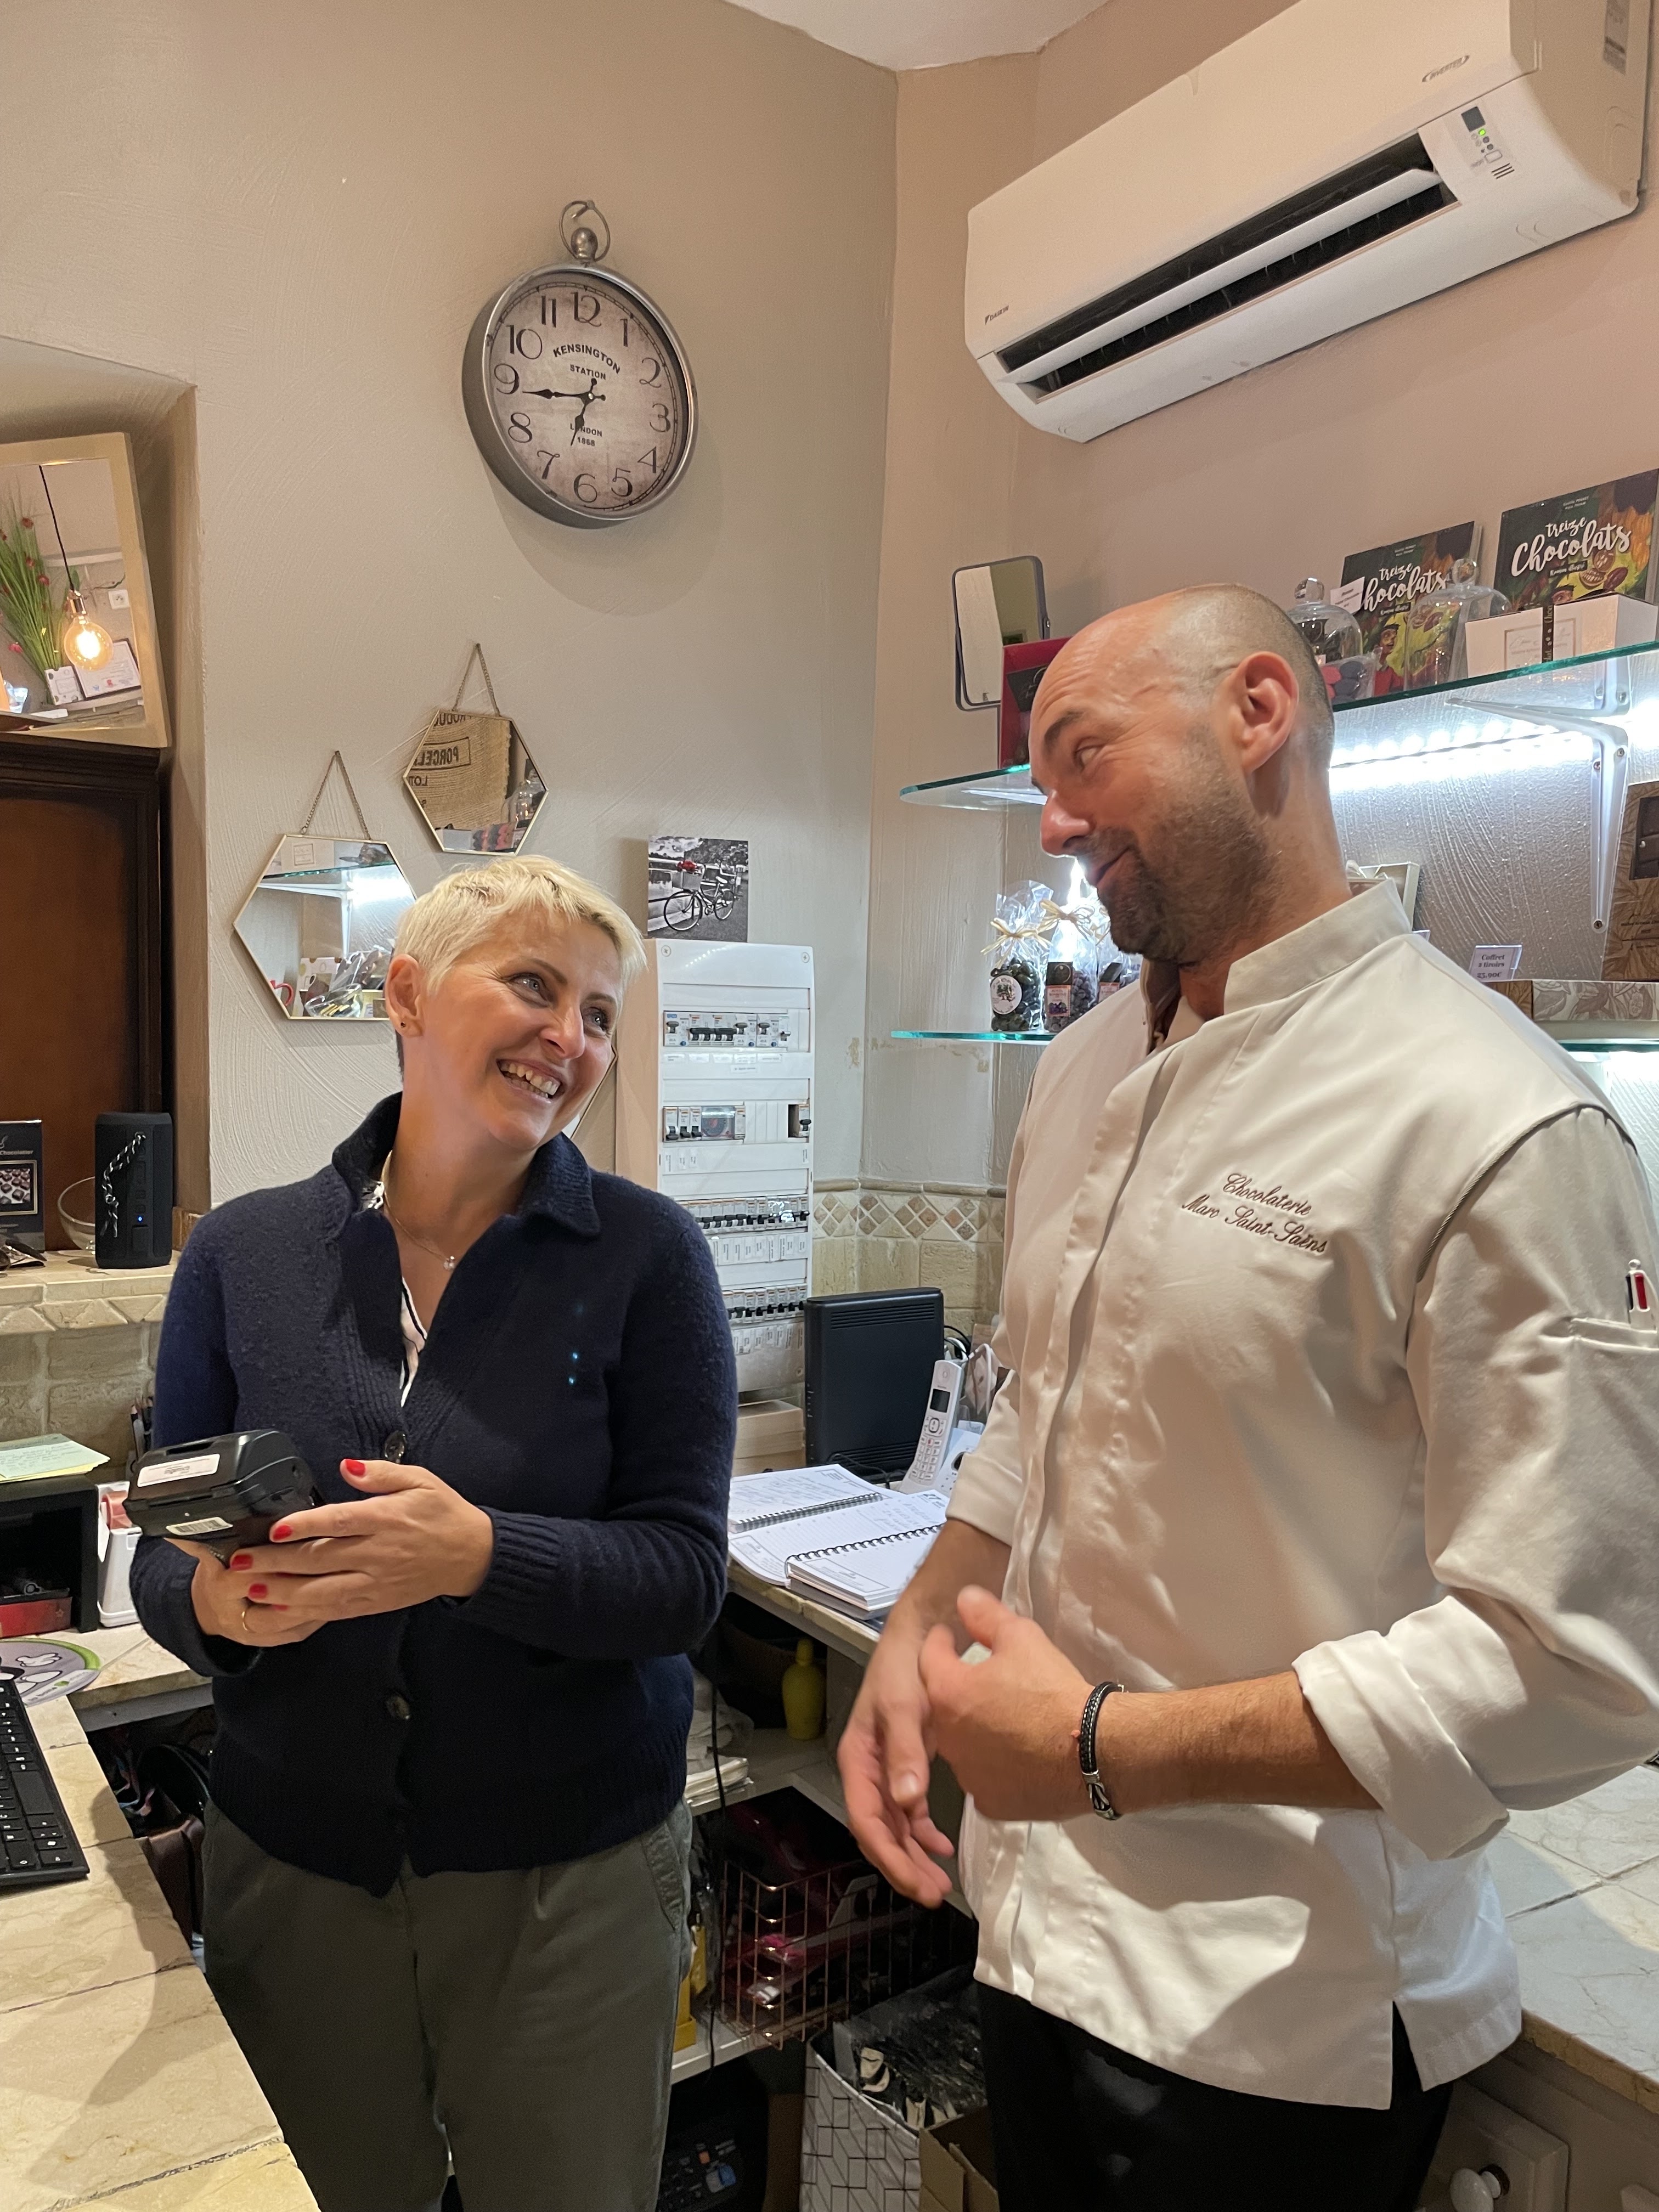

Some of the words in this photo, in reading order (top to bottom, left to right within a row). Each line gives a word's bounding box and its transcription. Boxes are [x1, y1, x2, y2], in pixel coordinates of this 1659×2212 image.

[540, 295, 556, 328] 11
[570, 291, 602, 327] 12
[506, 325, 543, 360] 10
[620, 318, 629, 347] 1
[552, 344, 620, 374] KENSINGTON
[569, 364, 606, 380] STATION
[639, 357, 662, 388] 2
[494, 363, 520, 394] 9
[507, 412, 533, 443] 8
[570, 423, 602, 437] LNDON
[649, 403, 671, 432] 3
[537, 450, 560, 479] 7
[637, 446, 657, 473] 4
[574, 473, 597, 503] 6
[611, 467, 633, 497] 5
[1545, 516, 1587, 538] treize
[1511, 520, 1632, 577] Chocolats
[1379, 563, 1413, 582] treize
[1363, 566, 1447, 612] hocolats
[1223, 1173, 1312, 1216] Chocolaterie
